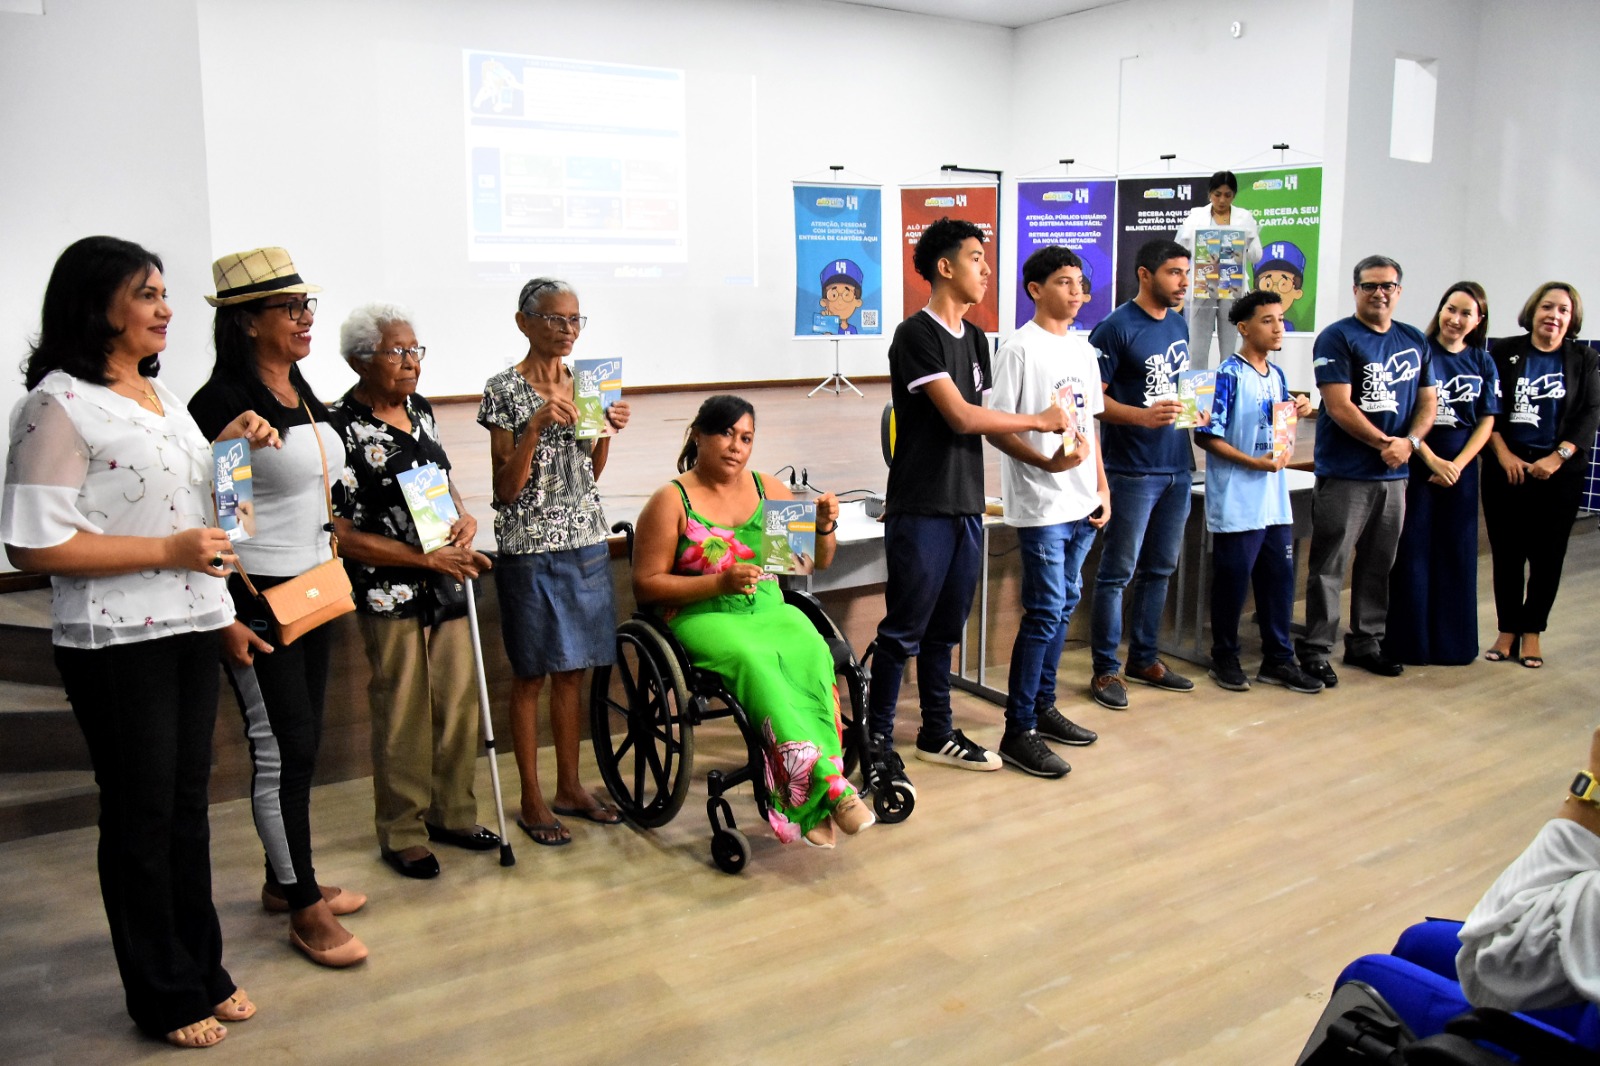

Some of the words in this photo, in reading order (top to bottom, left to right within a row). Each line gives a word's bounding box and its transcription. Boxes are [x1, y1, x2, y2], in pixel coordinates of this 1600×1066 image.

[1264, 208, 1298, 216] RECEBA
[1300, 206, 1318, 214] SEU
[1259, 216, 1294, 226] CARTÃO
[1296, 217, 1319, 226] AQUI
[1153, 354, 1165, 365] BI
[1373, 363, 1383, 372] BI
[1145, 355, 1155, 395] NOVA
[1155, 374, 1169, 385] TA
[1372, 372, 1393, 381] LHE
[1362, 363, 1372, 400] NOVA
[1372, 381, 1387, 390] TA
[1517, 377, 1530, 386] BI
[1155, 383, 1177, 394] GEM
[1515, 385, 1539, 395] LHE
[1371, 391, 1396, 400] GEM
[1437, 388, 1450, 400] HE
[1514, 394, 1529, 404] TA
[1437, 406, 1455, 416] EM
[1514, 403, 1539, 414] GEM
